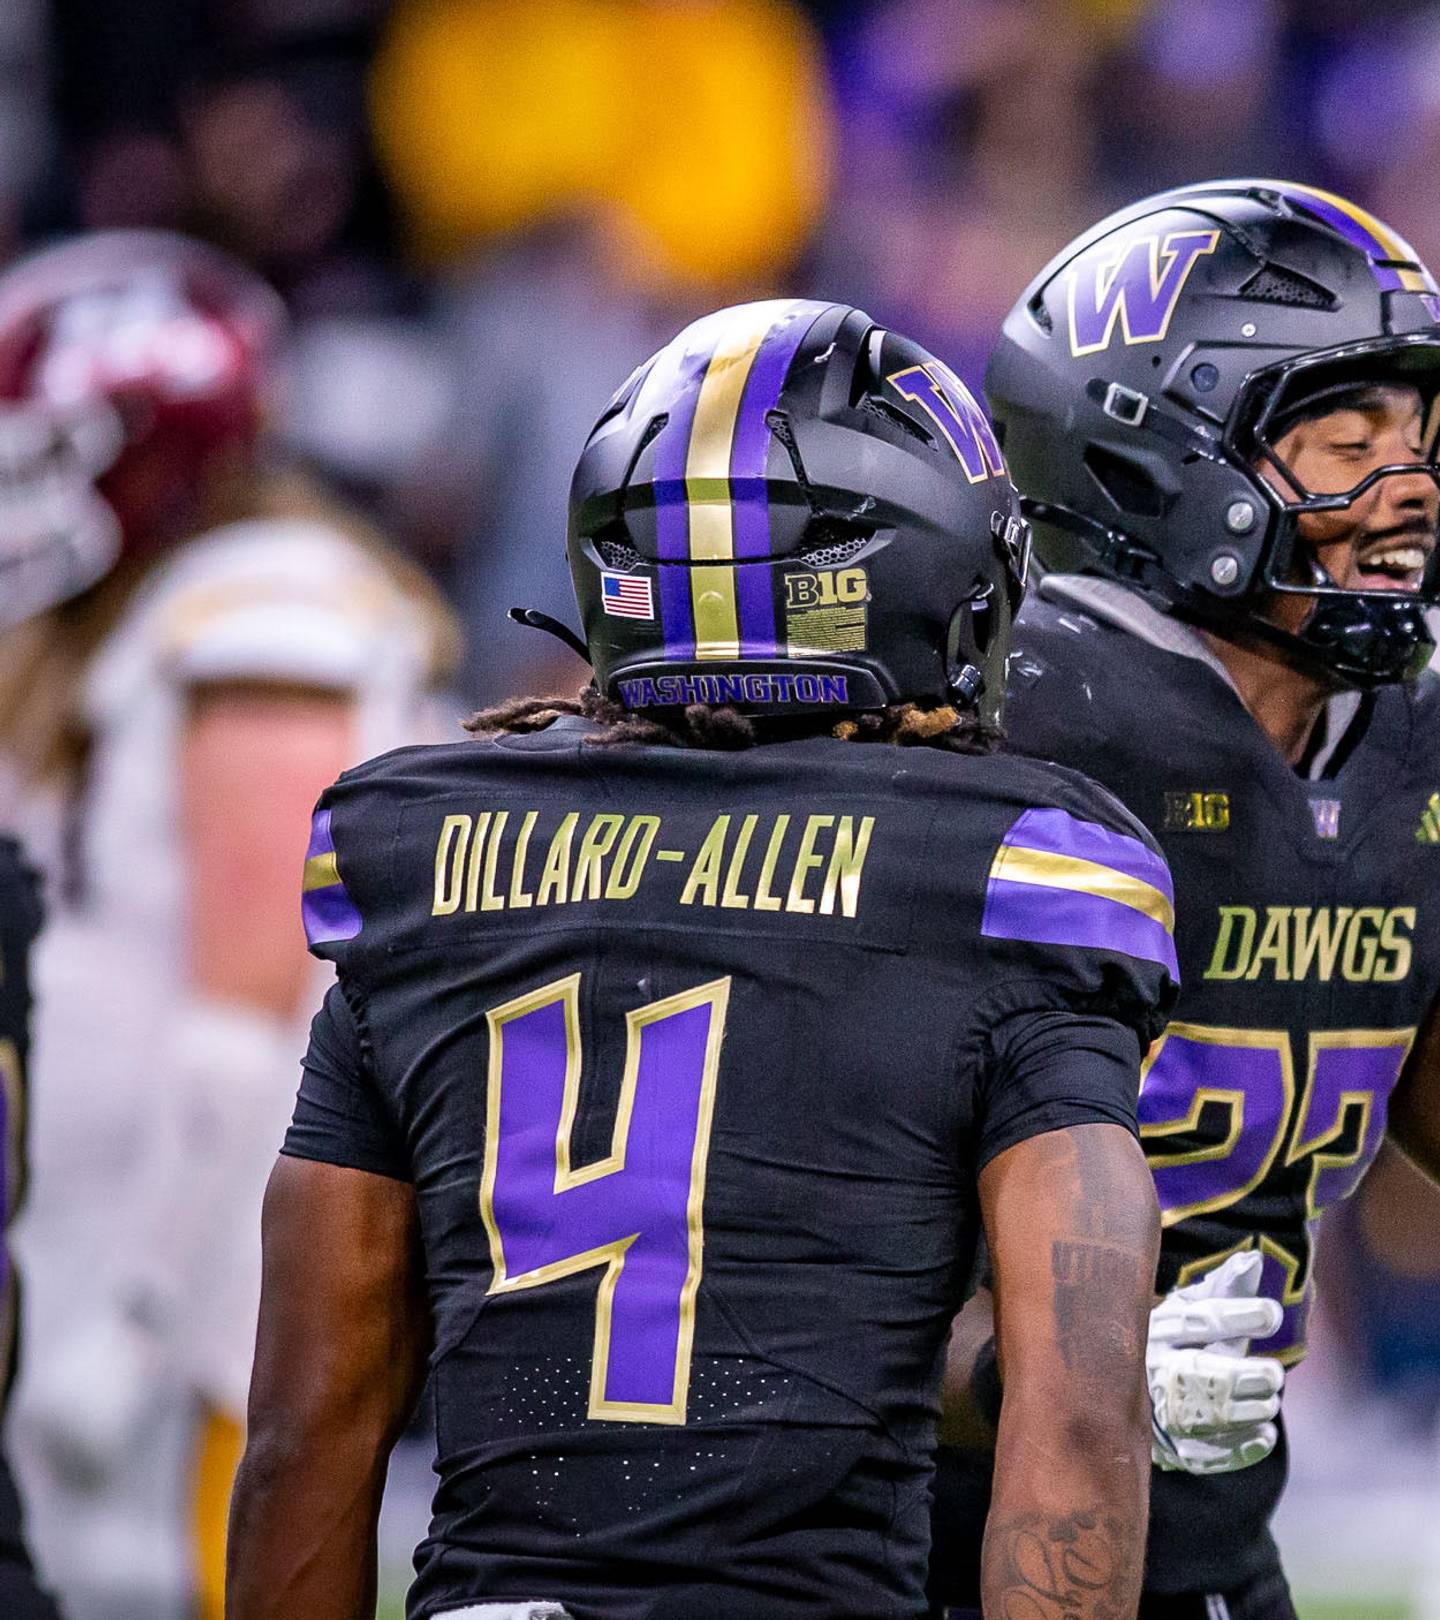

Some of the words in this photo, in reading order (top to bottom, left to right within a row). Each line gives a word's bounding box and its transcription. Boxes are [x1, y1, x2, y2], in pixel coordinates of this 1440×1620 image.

[1063, 229, 1221, 358] W
[885, 360, 1005, 485] W
[617, 674, 849, 709] WASHINGTON
[431, 810, 876, 919] DILLARD-ALLEN
[1203, 905, 1417, 982] DAWGS
[479, 971, 732, 1426] 4
[1137, 1019, 1418, 1368] 23
